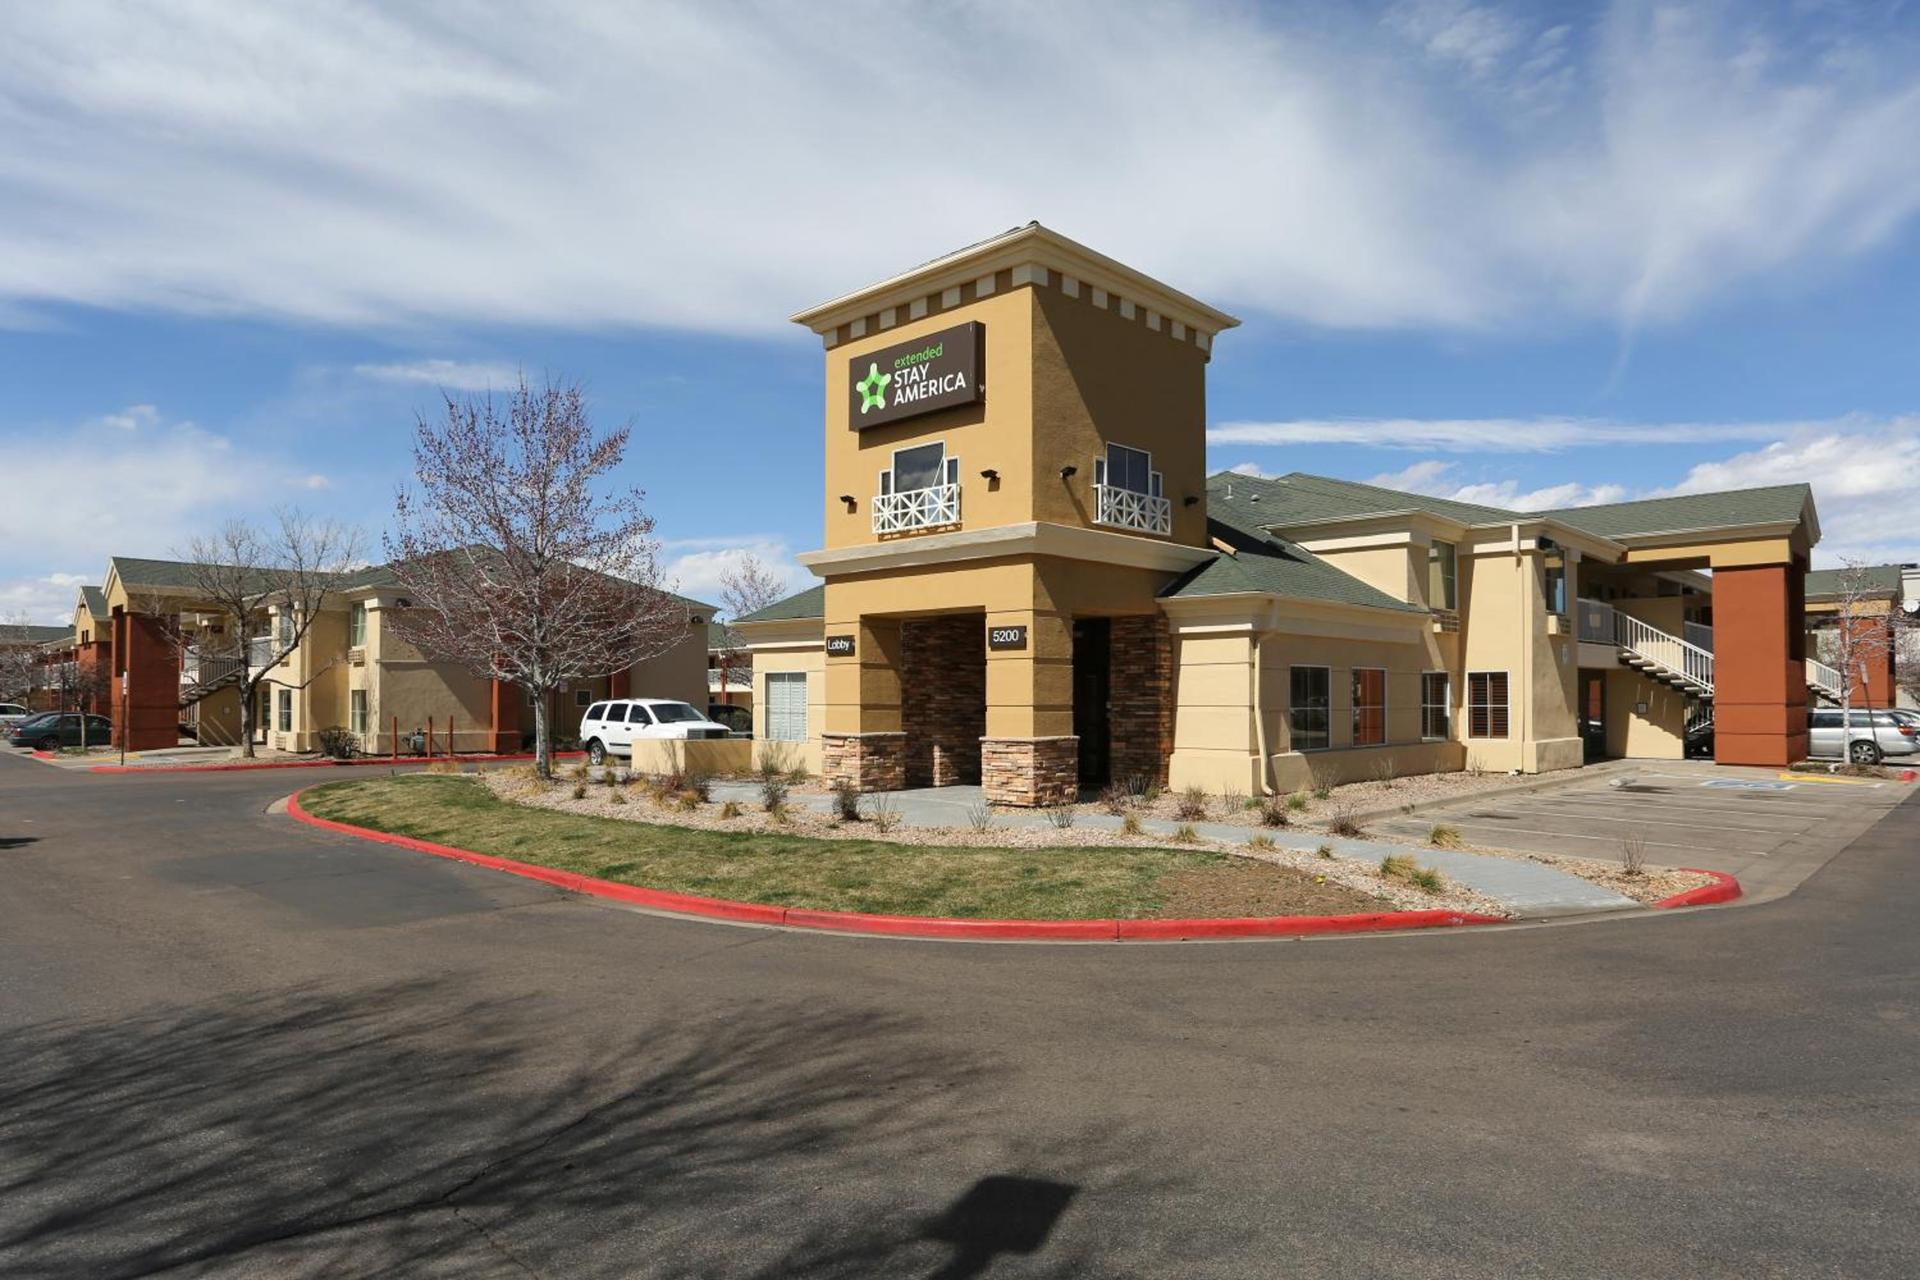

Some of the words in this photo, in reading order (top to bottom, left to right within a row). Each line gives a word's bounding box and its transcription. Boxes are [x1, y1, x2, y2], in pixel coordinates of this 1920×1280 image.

[894, 342, 943, 369] extended
[894, 362, 930, 388] STAY
[893, 371, 966, 406] AMERICA
[827, 638, 850, 651] Lobby
[992, 629, 1019, 642] 5200
